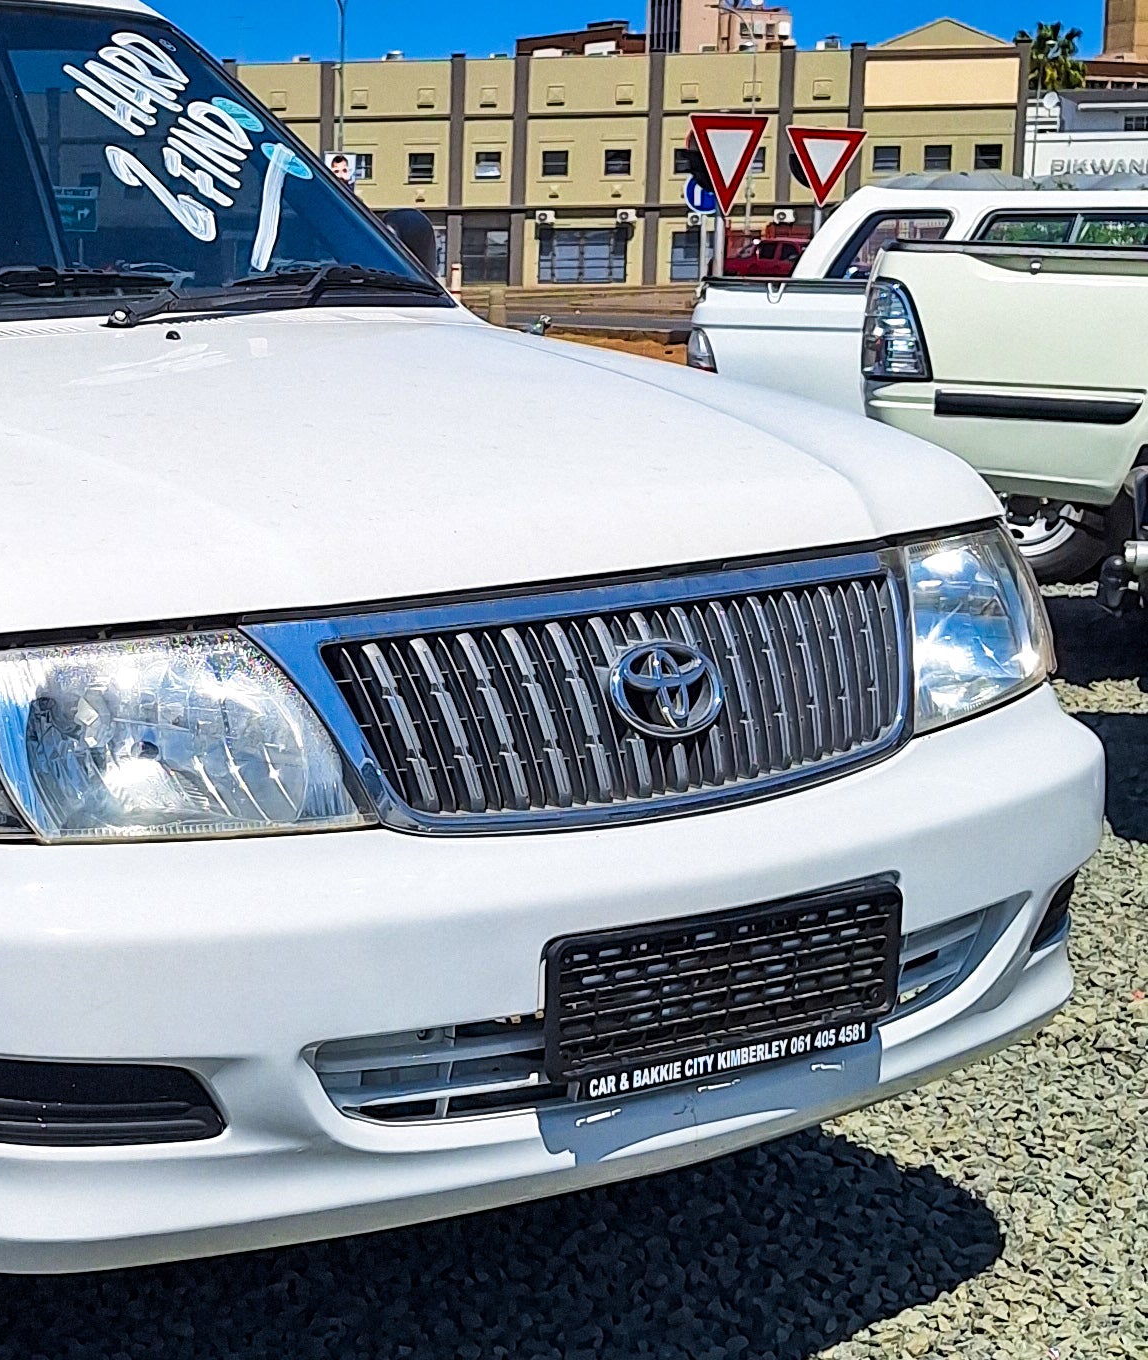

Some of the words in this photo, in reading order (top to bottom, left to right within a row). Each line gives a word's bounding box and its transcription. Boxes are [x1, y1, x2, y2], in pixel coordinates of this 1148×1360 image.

[63, 32, 190, 136] HARD
[162, 101, 254, 207] FIND
[589, 1075, 617, 1097] CAR
[619, 1072, 630, 1091] &
[632, 1061, 682, 1088] BAKKIE
[684, 1053, 715, 1077] CITY
[717, 1038, 789, 1070] KIMBERLEY
[790, 1033, 812, 1054] 061
[814, 1028, 836, 1049] 405
[838, 1021, 866, 1043] 4581
